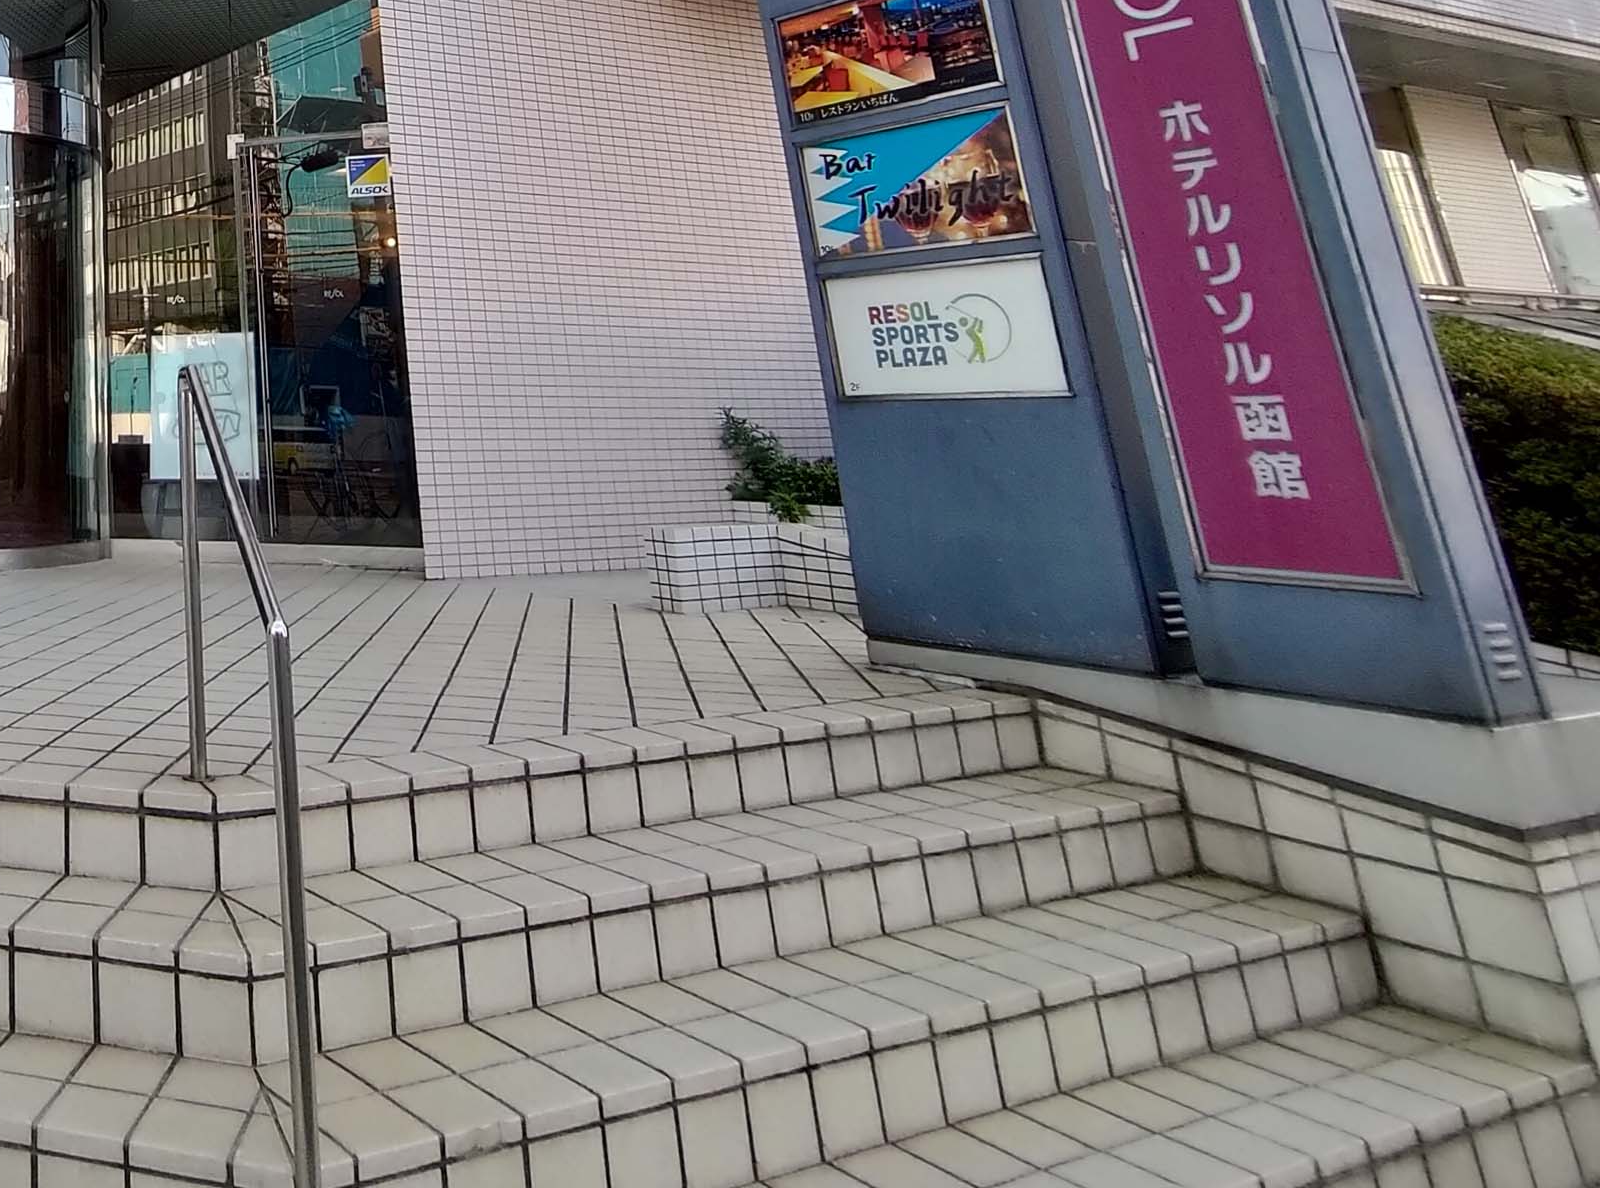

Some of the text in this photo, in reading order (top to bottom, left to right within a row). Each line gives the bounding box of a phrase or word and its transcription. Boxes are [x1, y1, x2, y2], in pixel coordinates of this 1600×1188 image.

[819, 153, 876, 180] Bar
[351, 185, 389, 195] ALSOK
[848, 169, 1013, 227] Twilight
[1159, 100, 1311, 500] ホテルリソル函館
[867, 301, 939, 325] RESOL
[871, 322, 959, 347] SPORTS
[875, 345, 948, 368] PLAZA
